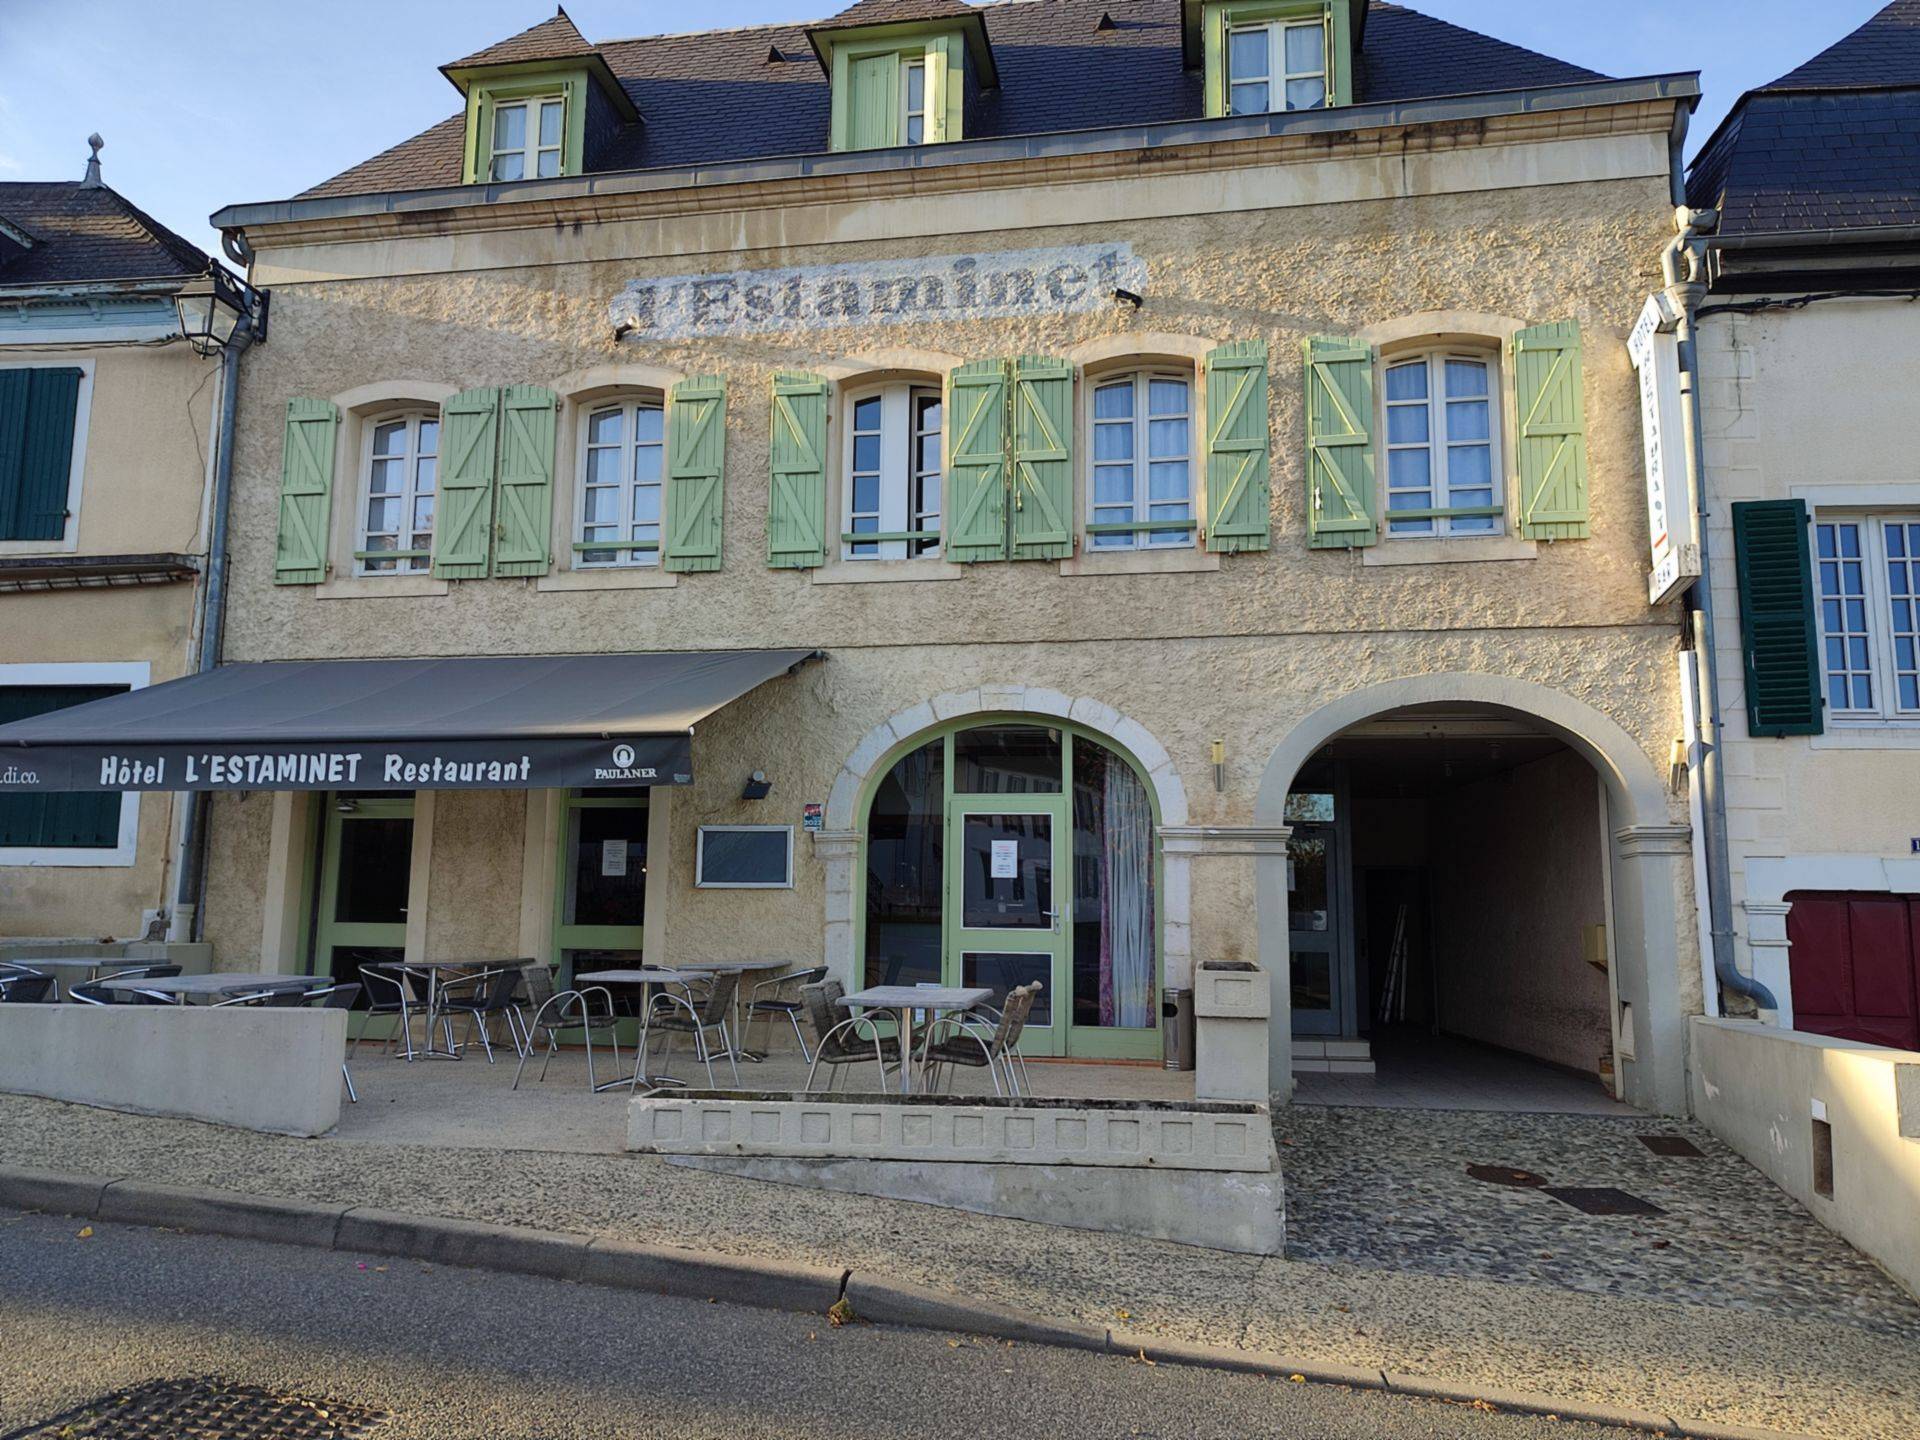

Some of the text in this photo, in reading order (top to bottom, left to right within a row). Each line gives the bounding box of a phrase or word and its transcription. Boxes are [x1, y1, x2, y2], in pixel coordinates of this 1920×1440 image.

[100, 753, 531, 785] Hôtel L'ESTAMINET Restaurant
[594, 767, 658, 780] PAULANER
